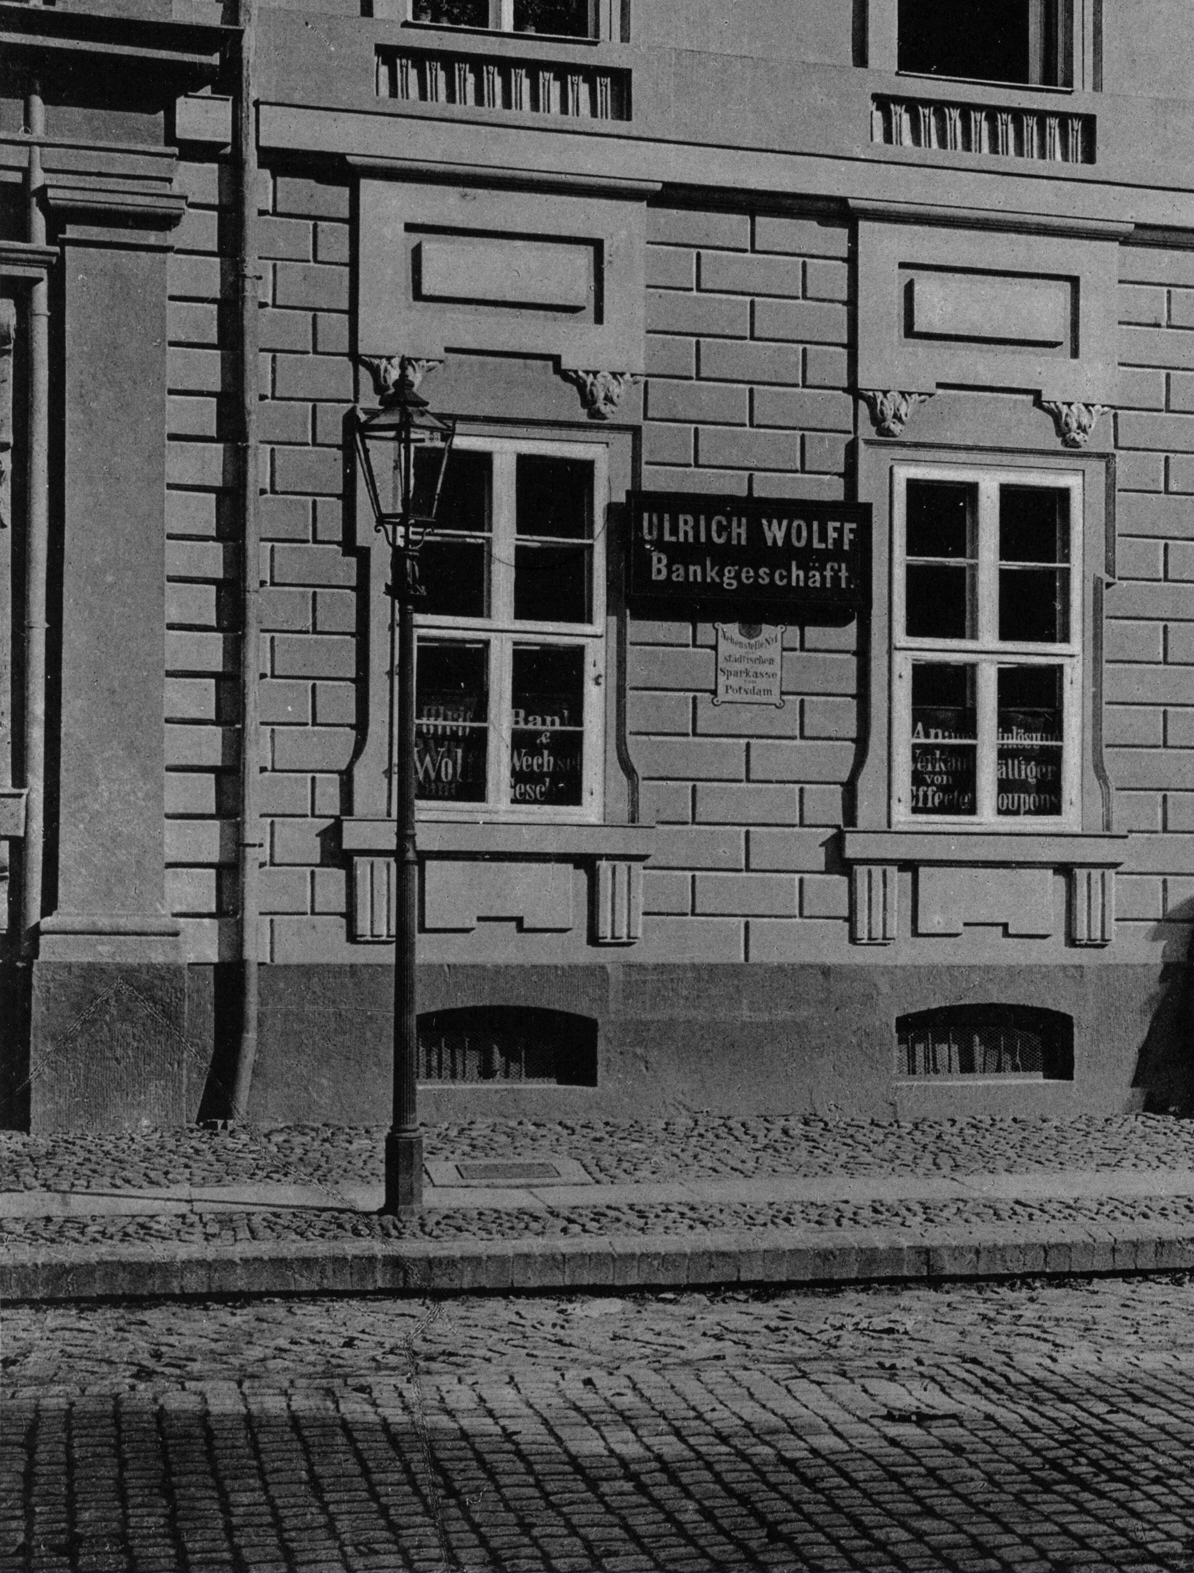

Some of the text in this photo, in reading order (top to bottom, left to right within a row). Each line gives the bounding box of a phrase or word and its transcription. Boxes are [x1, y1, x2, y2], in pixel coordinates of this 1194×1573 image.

[642, 512, 858, 550] ULRICH WOLFF
[719, 668, 778, 681] Sparkasse
